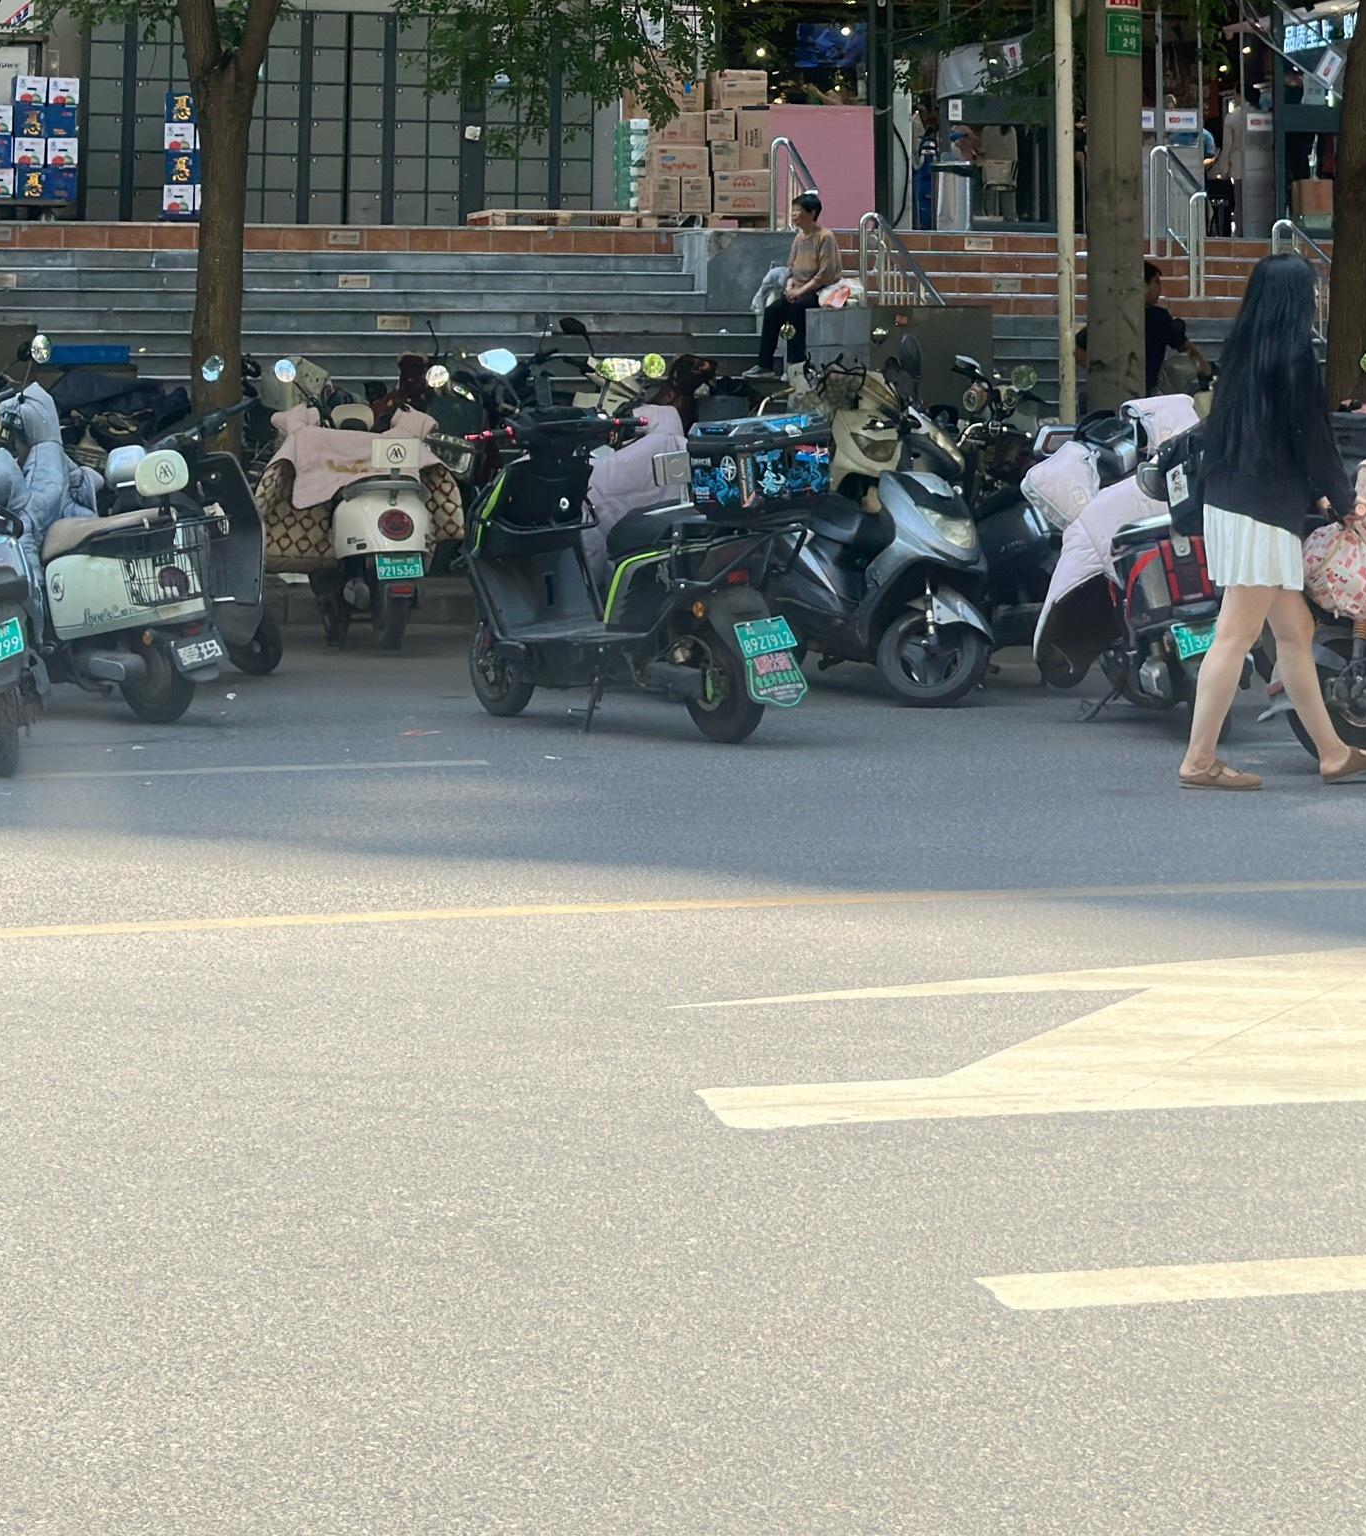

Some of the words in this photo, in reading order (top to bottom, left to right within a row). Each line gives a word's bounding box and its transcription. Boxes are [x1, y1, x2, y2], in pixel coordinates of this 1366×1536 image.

[378, 564, 421, 578] 9215367
[178, 638, 223, 666] 爱玛
[743, 631, 793, 654] 8927912
